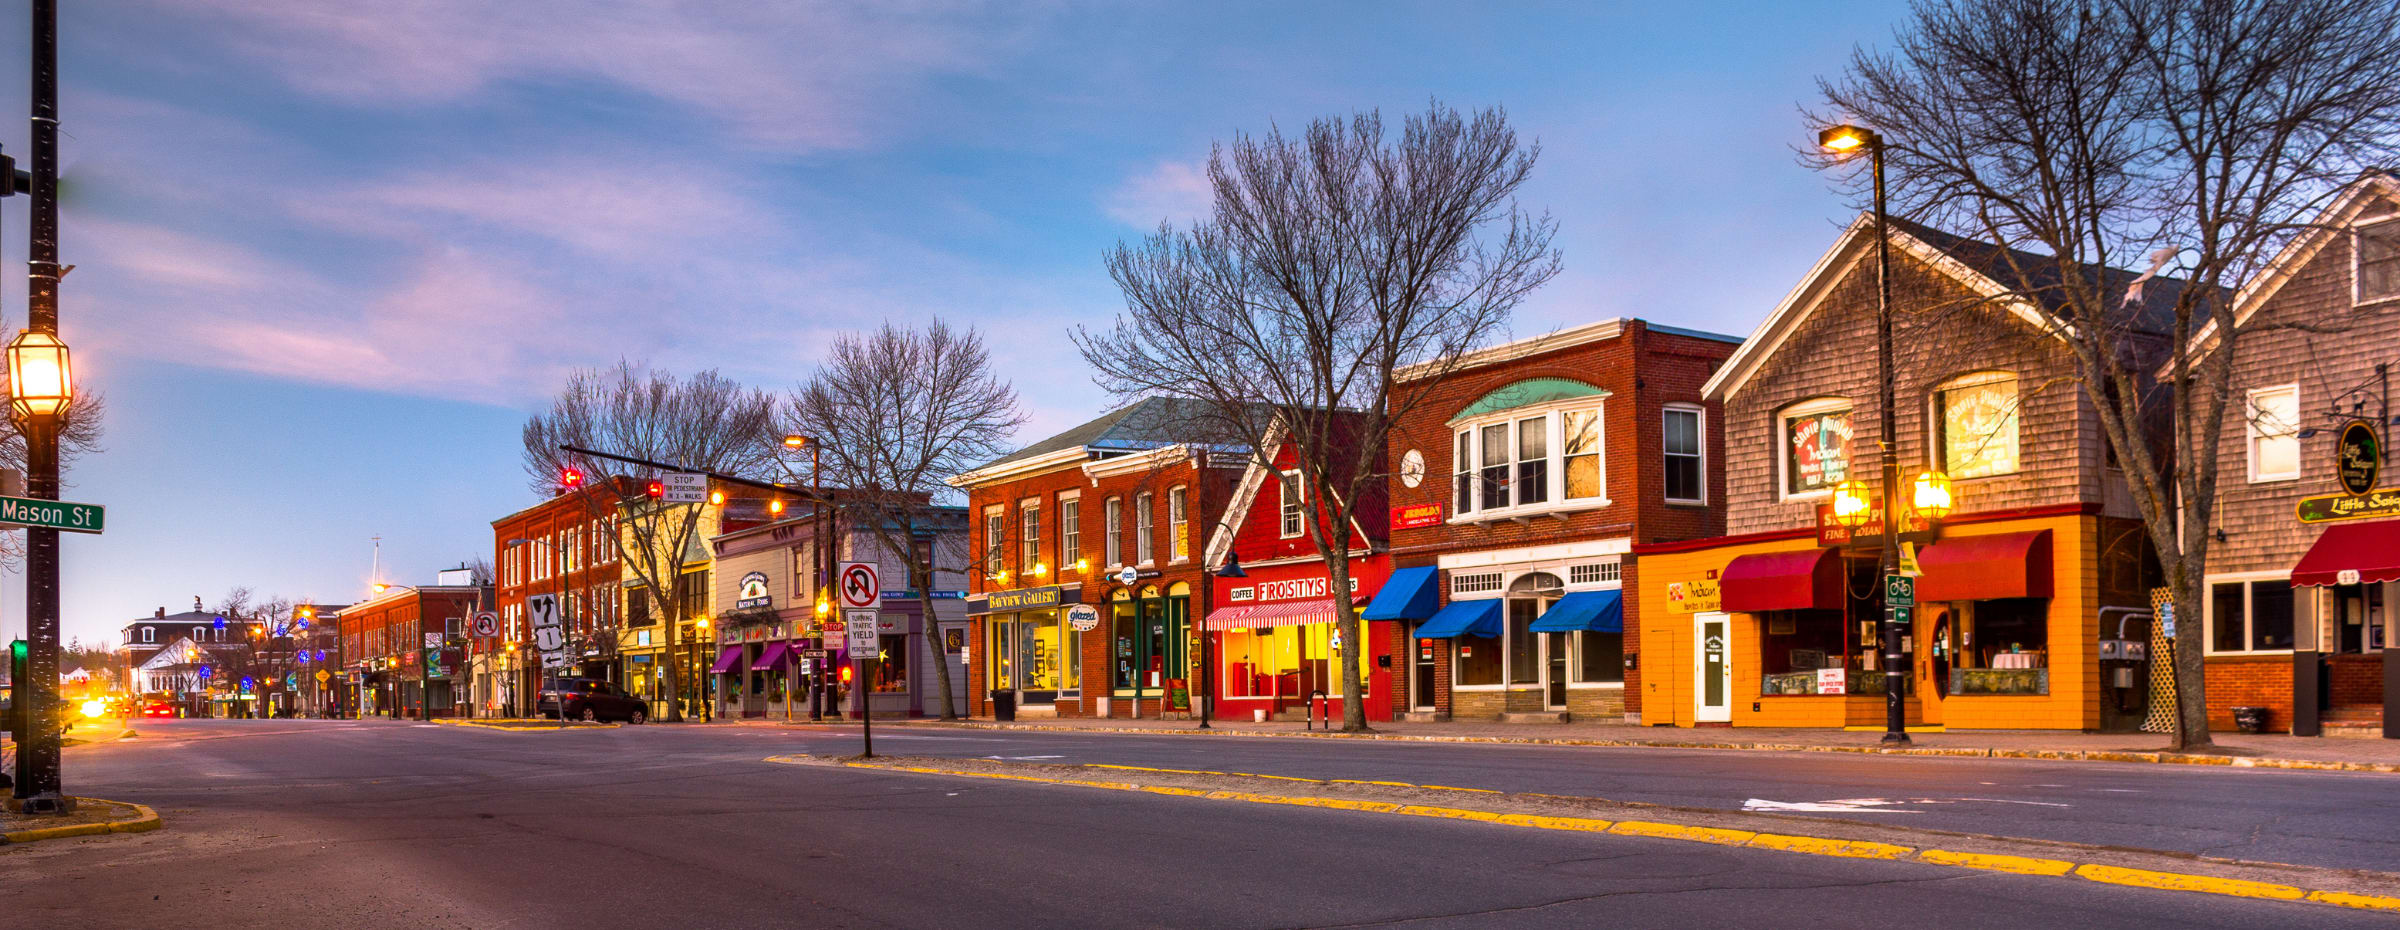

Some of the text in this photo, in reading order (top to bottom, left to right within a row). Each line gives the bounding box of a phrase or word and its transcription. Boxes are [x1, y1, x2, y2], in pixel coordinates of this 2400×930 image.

[674, 476, 695, 484] STOP
[2, 500, 92, 526] Mason St
[2330, 498, 2366, 515] Little
[1825, 529, 1845, 540] FINE
[1231, 589, 1253, 599] COFFEE
[1259, 578, 1325, 600] FROSTYS
[1069, 609, 1096, 622] glazed
[546, 631, 553, 646] 1
[852, 631, 874, 640] YIELD
[565, 656, 575, 665] 24
